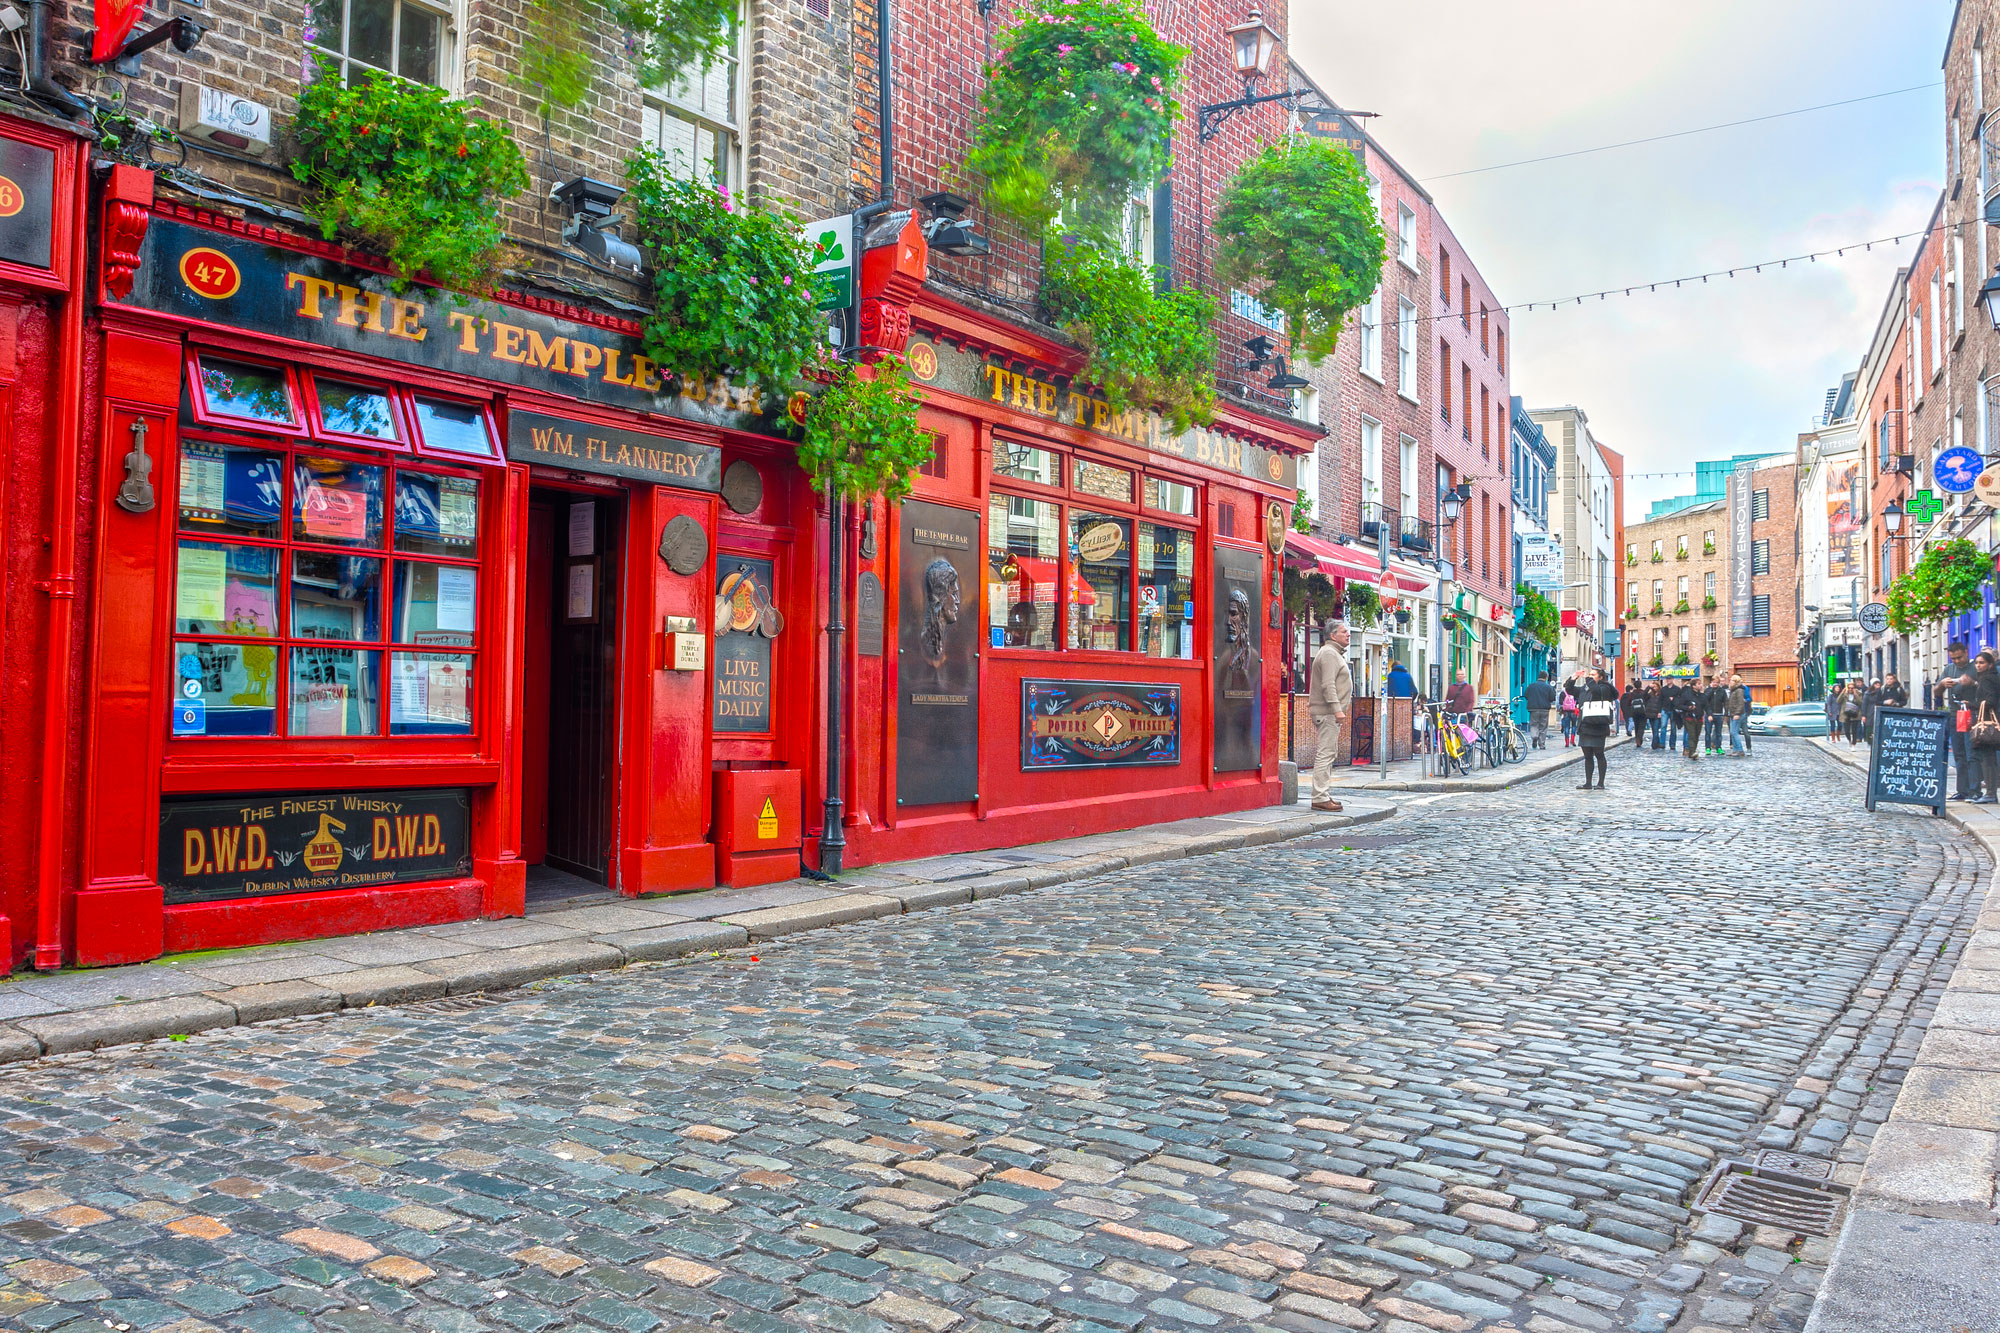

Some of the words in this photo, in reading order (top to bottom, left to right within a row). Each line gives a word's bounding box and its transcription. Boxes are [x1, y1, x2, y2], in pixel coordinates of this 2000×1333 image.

[1316, 121, 1340, 132] THE
[194, 261, 226, 286] 47
[285, 272, 427, 342] THE
[448, 312, 661, 392] TEMPLE
[680, 370, 764, 416] BAR
[913, 351, 932, 375] 48
[985, 364, 1058, 417] THE
[1069, 390, 1185, 455] TEMPLE
[1195, 430, 1242, 472] BAR
[530, 427, 580, 458] WM.
[584, 437, 704, 477] FLANNERY
[1271, 459, 1281, 476] 48
[1736, 466, 1748, 553] ENROLLING
[914, 528, 928, 538] THE
[929, 530, 954, 542] TEMPLE
[955, 534, 968, 544] BAR
[1524, 554, 1549, 562] LIVE
[1737, 556, 1747, 596] NOW
[725, 660, 760, 677] LIVE
[718, 680, 765, 697] MUSIC
[719, 700, 763, 717] DAILY
[1048, 719, 1088, 733] POWERS
[1129, 718, 1167, 732] WHISKEY
[1892, 729, 1917, 740] Lunch
[1918, 730, 1936, 740] Deal
[1881, 739, 1910, 749] Starter
[1915, 741, 1937, 751] Main
[1880, 765, 1896, 775] Best
[1918, 767, 1937, 777] Deal
[1895, 757, 1909, 767] soft
[1911, 758, 1933, 768] drink
[1880, 774, 1909, 785] Around
[1913, 777, 1939, 799] 9.95
[240, 805, 275, 823] THE
[281, 800, 337, 816] FINEST
[342, 797, 403, 814] WHISKY
[372, 813, 447, 861] D.W.D.
[184, 824, 275, 877] D.W.D.
[245, 880, 290, 893] DUBLIN
[292, 876, 338, 889] WHISKY
[341, 871, 396, 885] DISTILLERY
